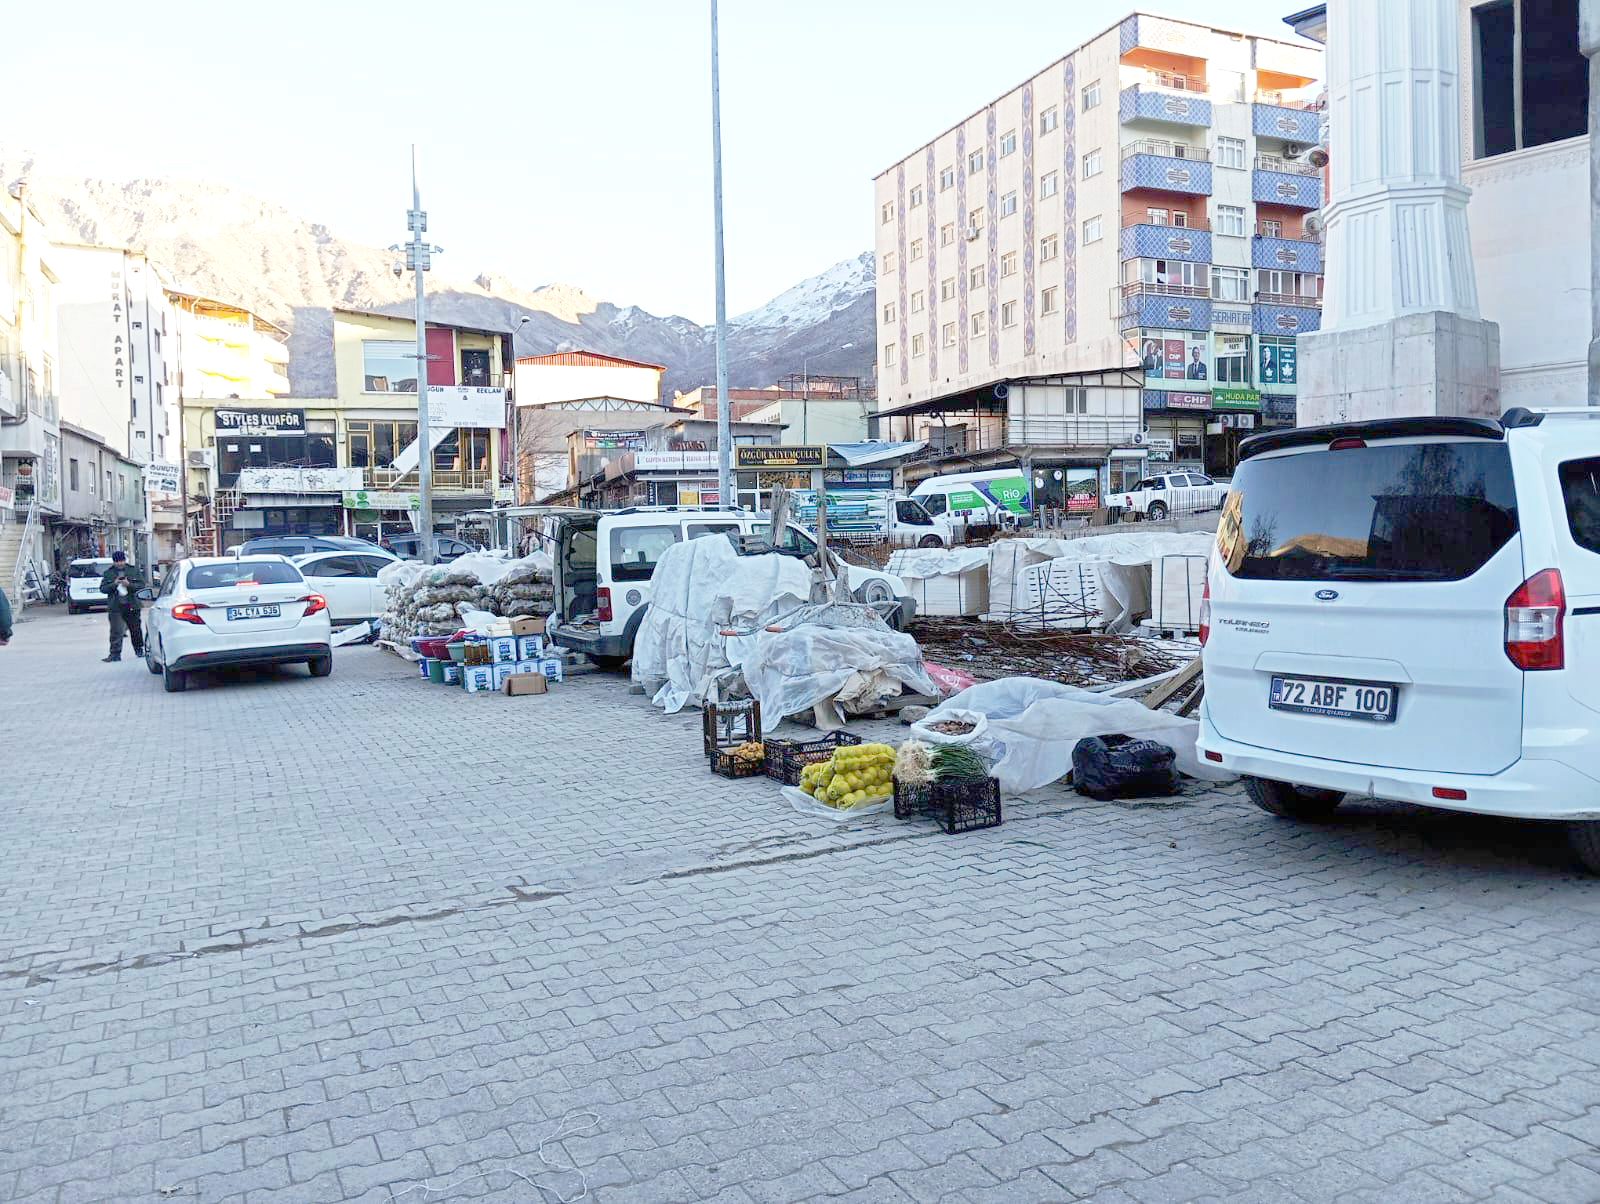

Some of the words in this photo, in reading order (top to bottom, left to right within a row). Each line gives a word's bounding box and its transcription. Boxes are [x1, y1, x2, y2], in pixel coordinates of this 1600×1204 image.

[111, 271, 121, 322] MURAT
[114, 335, 124, 388] APART
[1184, 395, 1207, 404] CHP
[222, 414, 259, 426] STYLES
[261, 412, 300, 426] KUAFÖR
[740, 449, 767, 459] ÖZGÜR
[769, 449, 821, 459] KUYUMCULUK
[232, 609, 242, 617] 34
[1283, 682, 1306, 704] 72
[1310, 684, 1347, 708] ABF
[1355, 688, 1389, 712] 100
